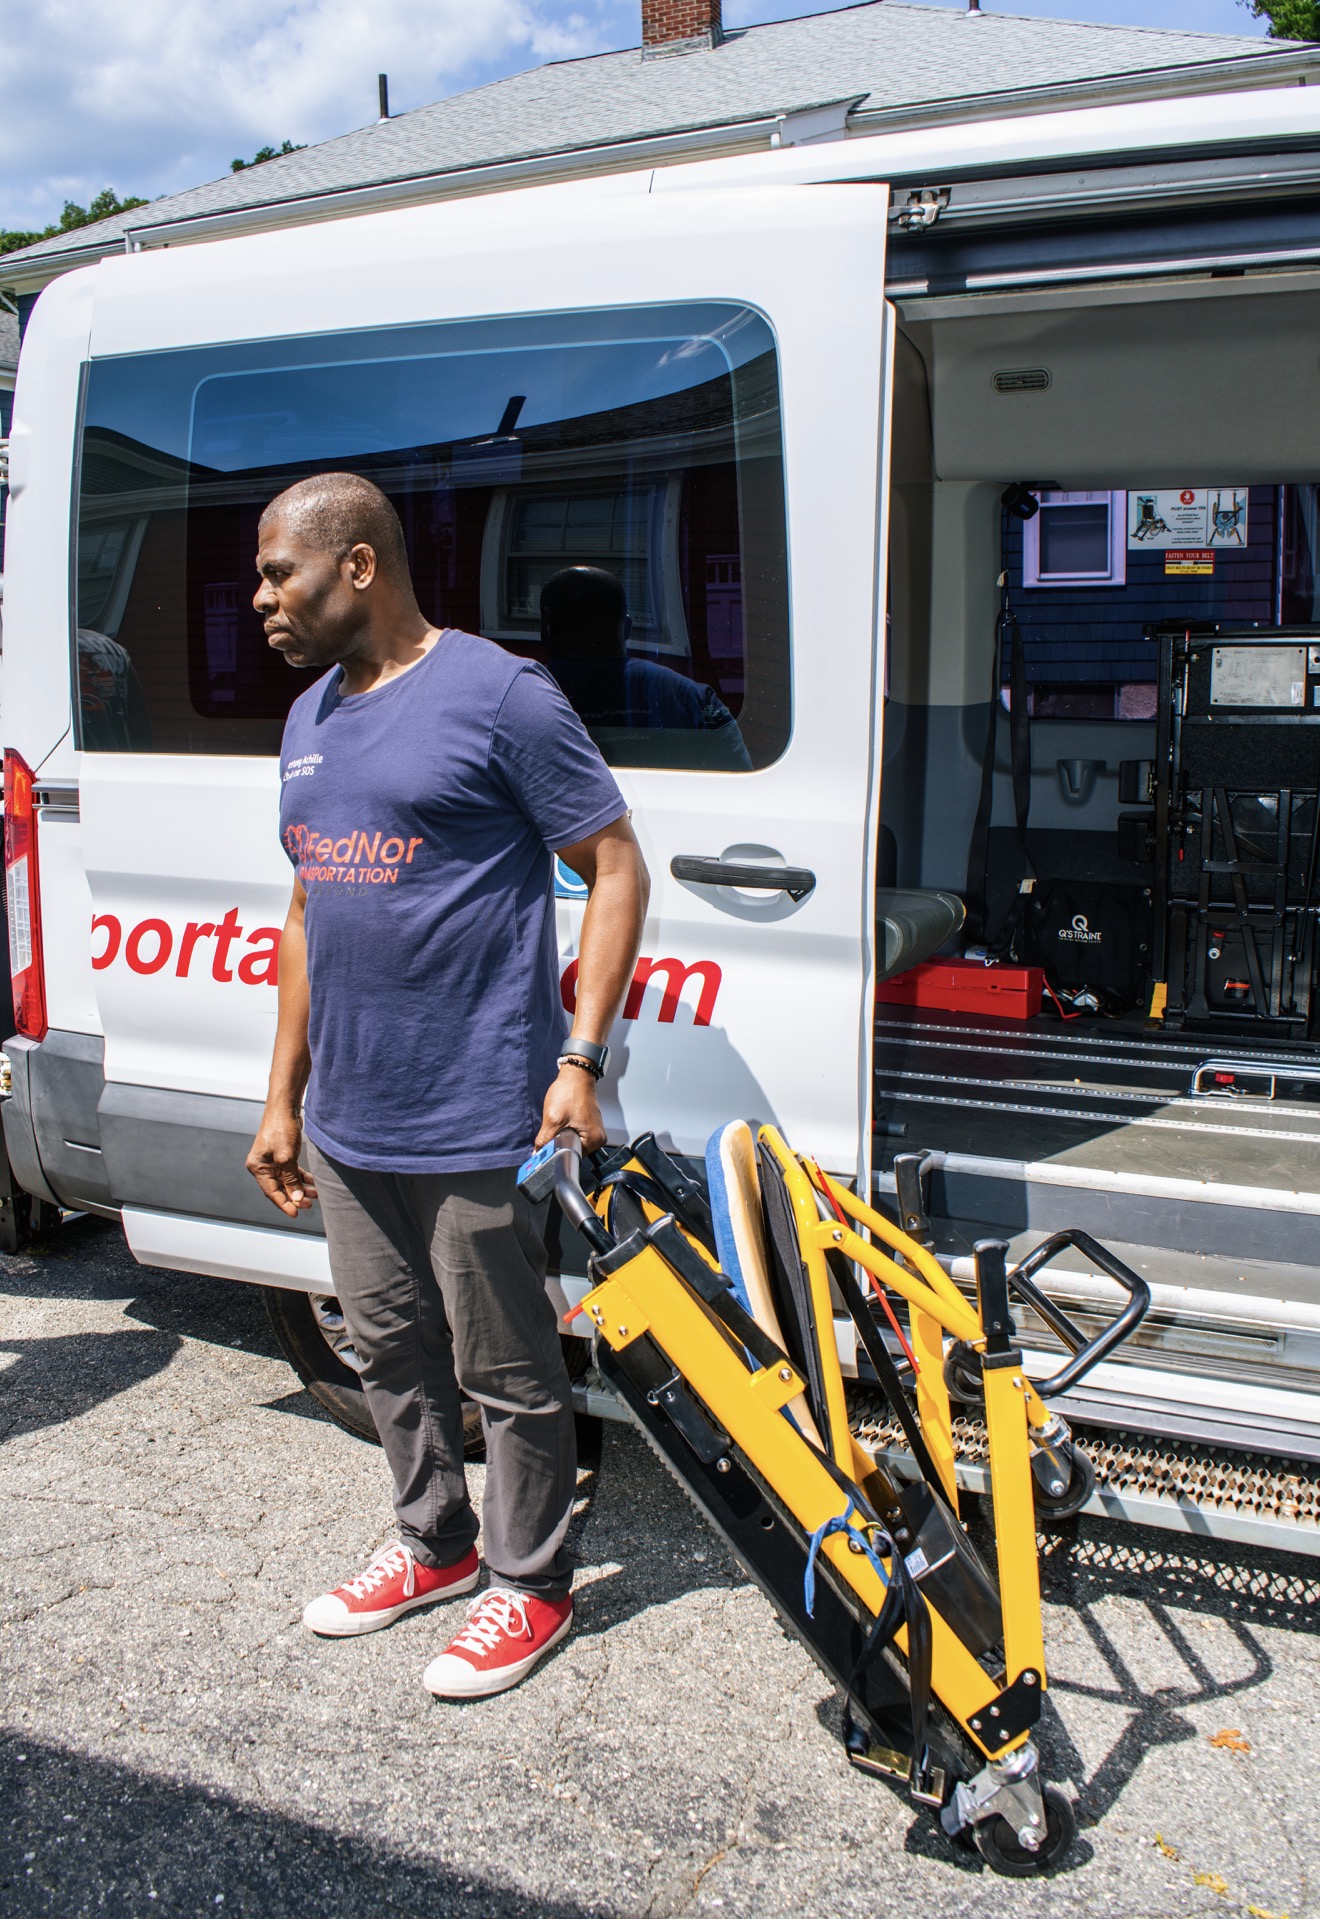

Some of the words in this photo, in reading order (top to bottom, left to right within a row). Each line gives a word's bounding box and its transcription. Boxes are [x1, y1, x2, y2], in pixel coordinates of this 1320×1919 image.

[300, 765, 316, 776] SOS
[307, 830, 424, 864] FedNor
[1058, 929, 1102, 940] Q'STRAINT
